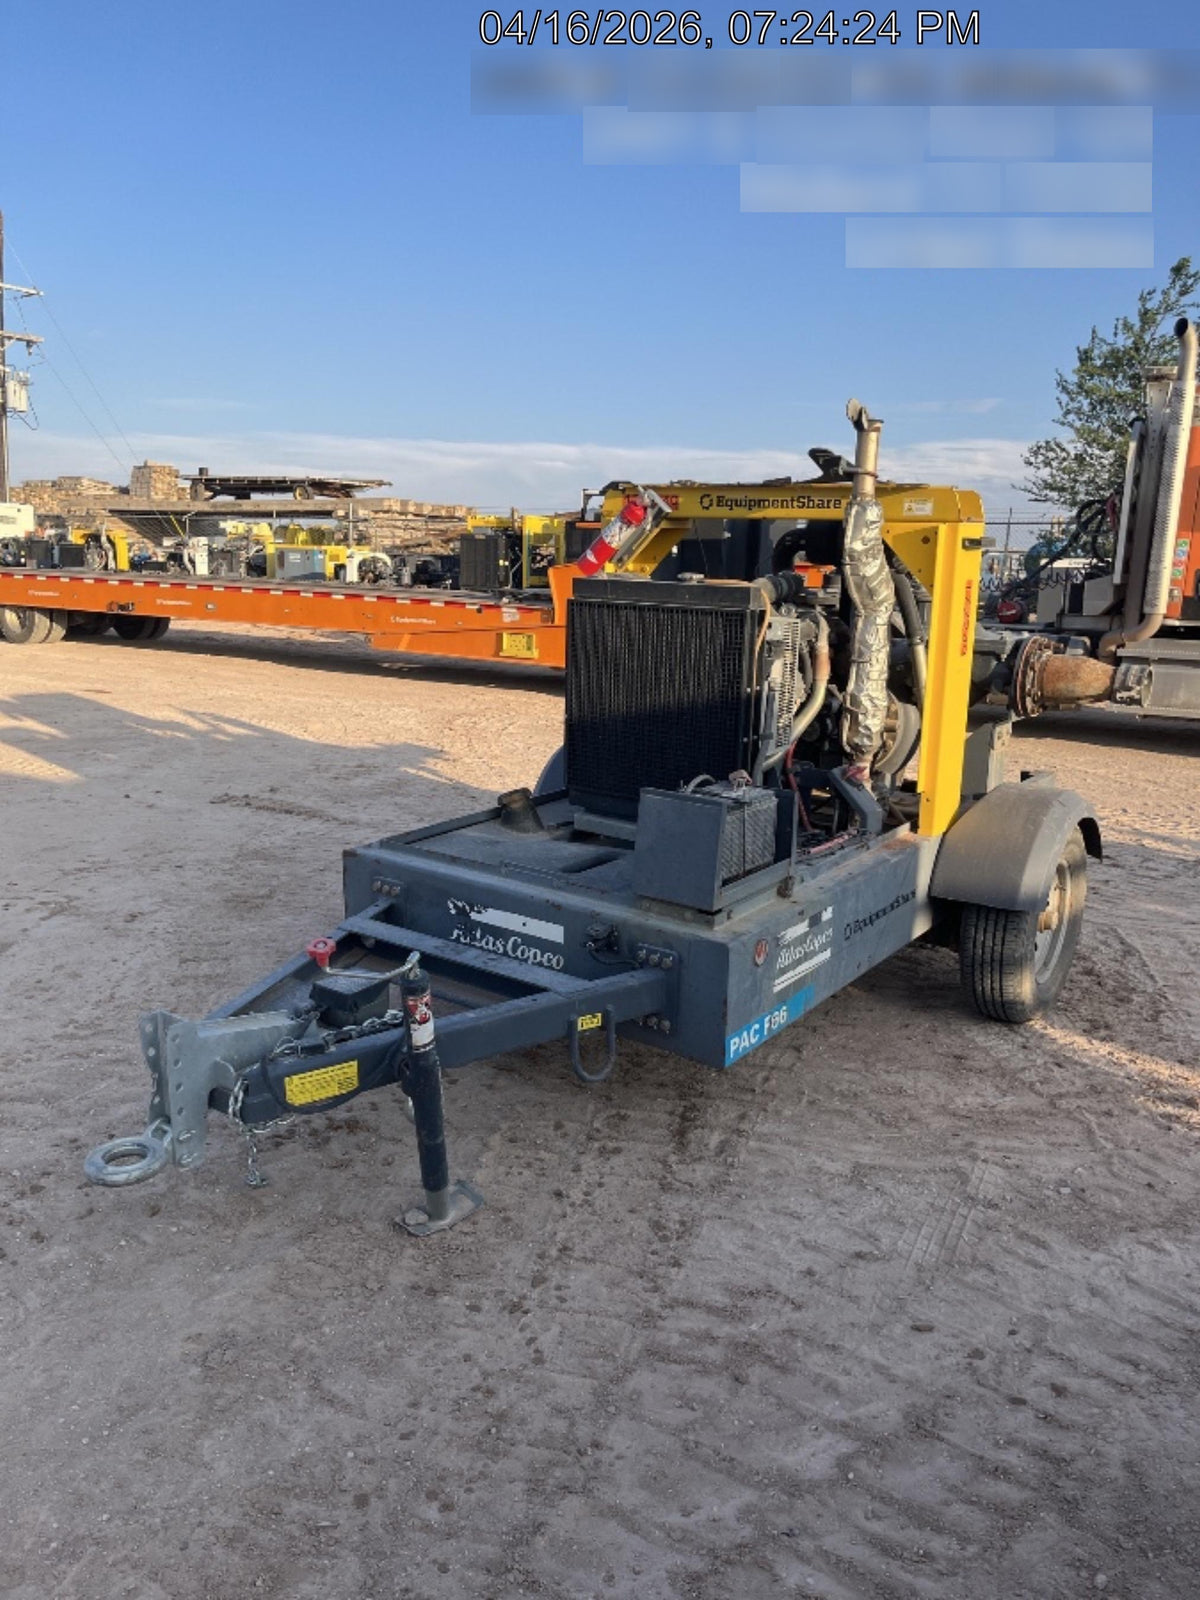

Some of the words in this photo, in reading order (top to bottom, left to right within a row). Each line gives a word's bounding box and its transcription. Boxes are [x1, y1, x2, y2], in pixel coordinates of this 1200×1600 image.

[715, 494, 842, 511] EquipmentShare
[506, 936, 565, 970] Copco
[729, 1022, 760, 1059] PAC
